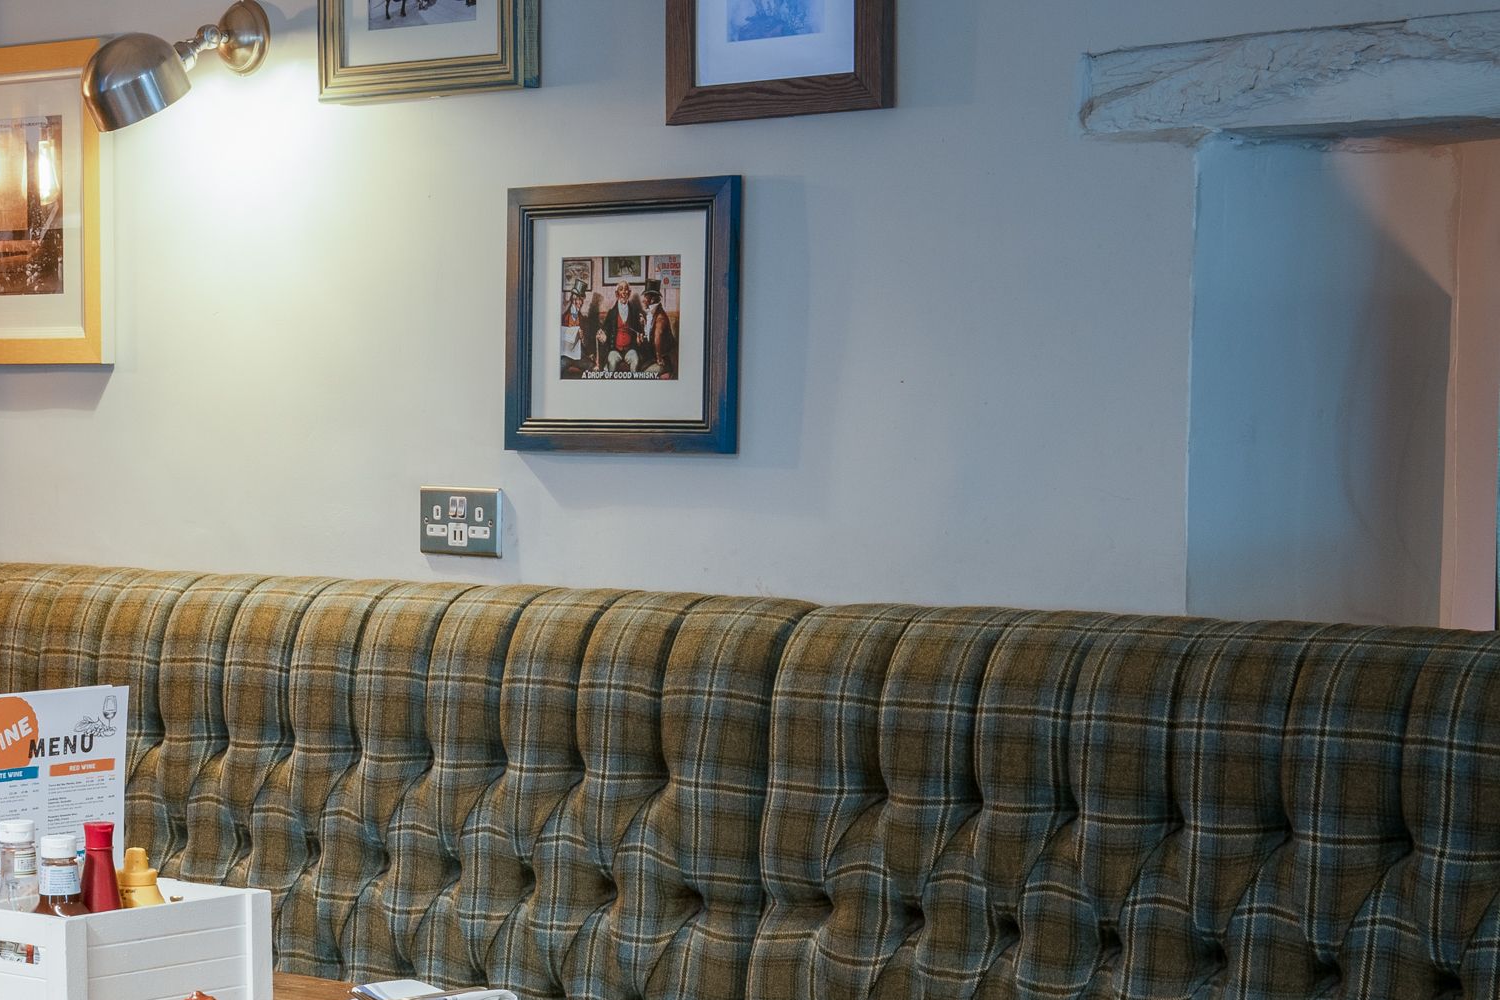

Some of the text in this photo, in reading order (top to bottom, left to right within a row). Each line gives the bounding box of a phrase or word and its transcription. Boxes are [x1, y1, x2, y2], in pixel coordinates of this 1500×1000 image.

[604, 371, 613, 379] OF
[613, 371, 632, 379] GOOD
[27, 733, 94, 759] MENU
[7, 770, 23, 778] WINE
